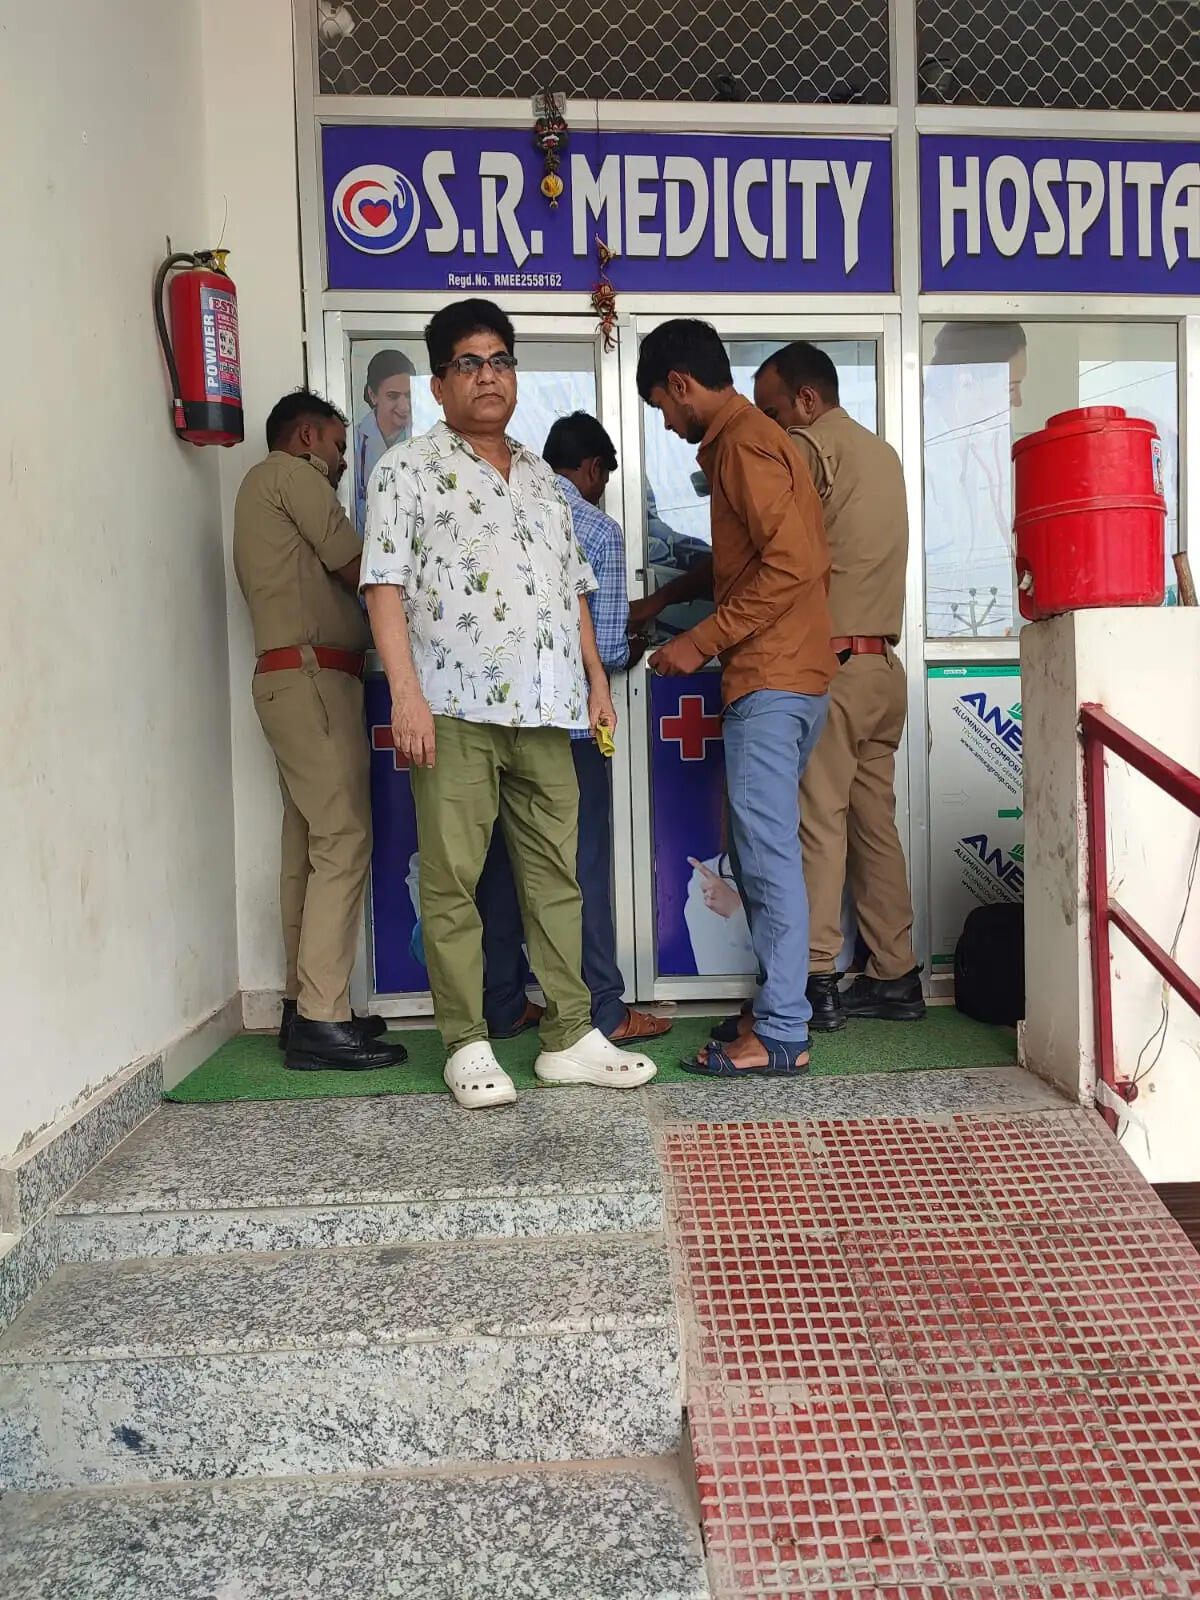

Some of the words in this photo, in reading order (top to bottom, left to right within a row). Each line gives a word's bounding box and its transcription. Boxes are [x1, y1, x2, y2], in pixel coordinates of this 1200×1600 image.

[422, 150, 543, 269] S.R.
[570, 154, 873, 274] MEDICITY
[939, 155, 1200, 270] HOSPITA
[448, 273, 491, 288] Regd.No.
[494, 273, 562, 287] RMEE2558162
[203, 314, 218, 387] POWDER
[952, 706, 992, 744] ALUMINIUM
[960, 692, 1022, 758] ANE
[954, 848, 992, 885] ALUMINIUM
[961, 834, 1024, 898] ANE
